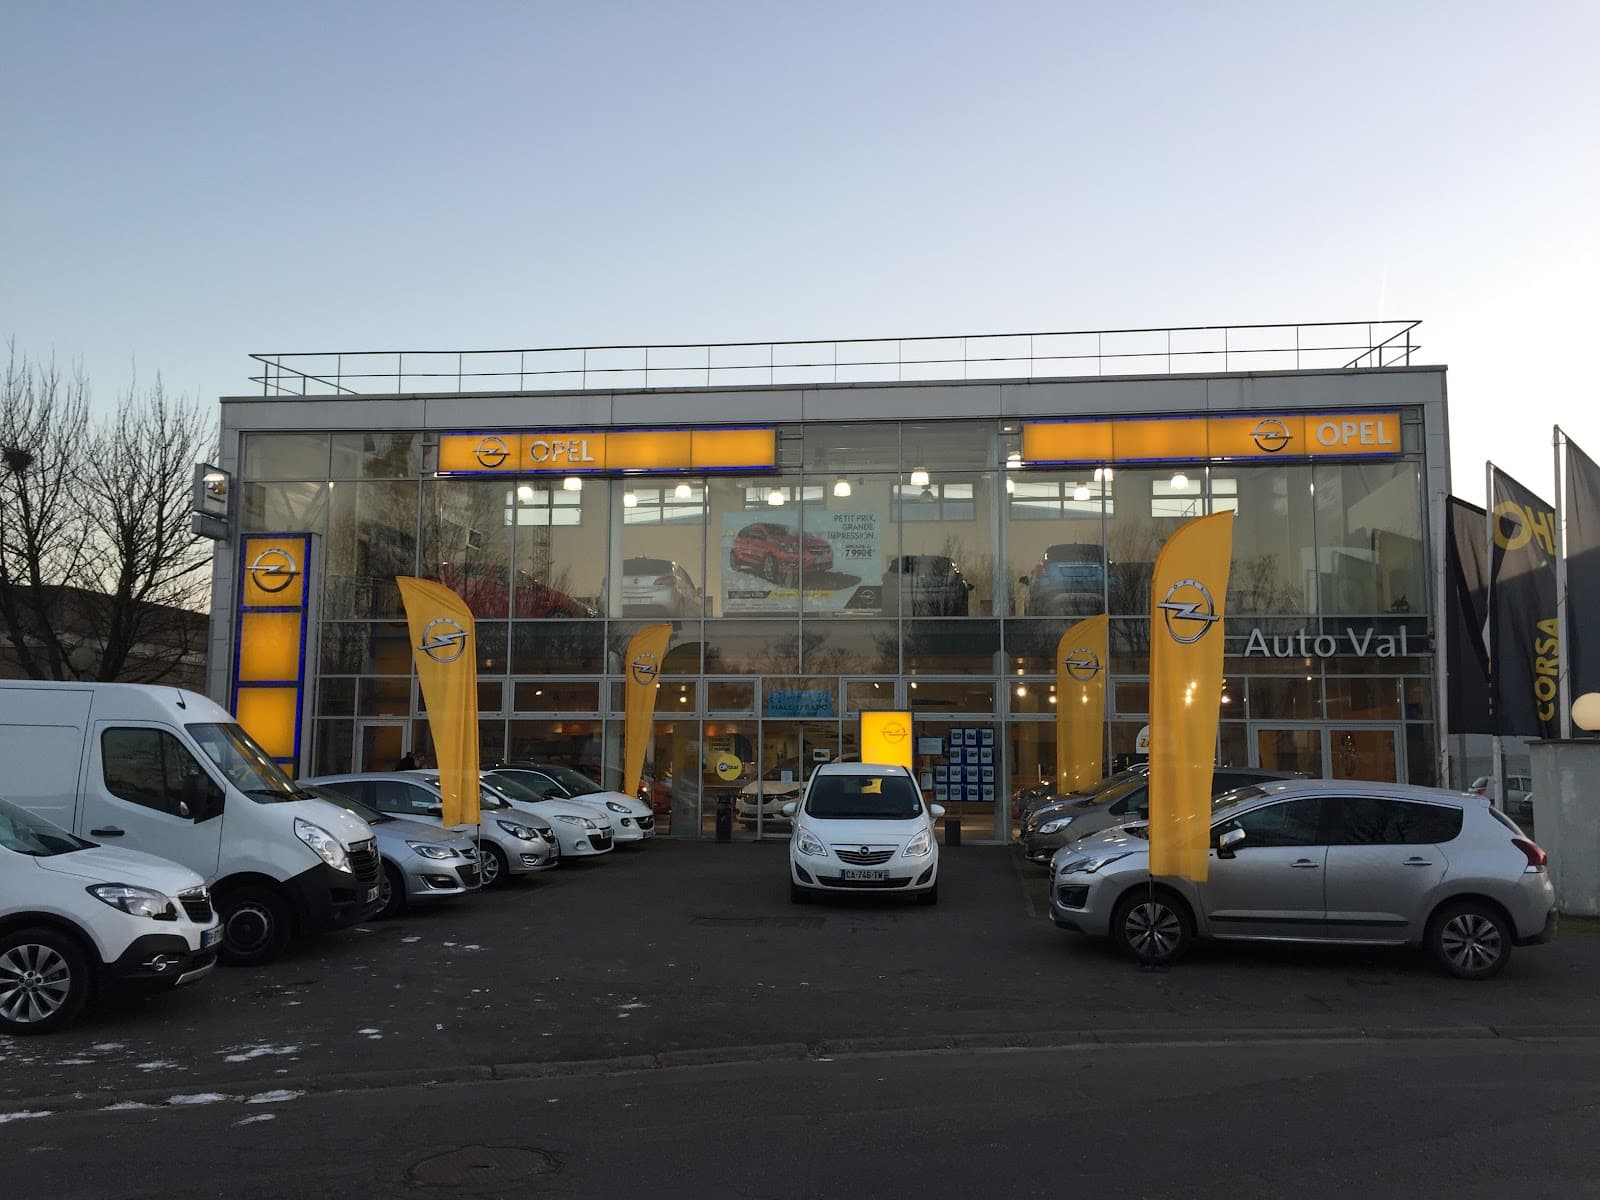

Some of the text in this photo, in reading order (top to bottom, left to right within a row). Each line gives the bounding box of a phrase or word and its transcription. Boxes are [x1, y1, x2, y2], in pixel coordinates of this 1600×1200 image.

[1316, 421, 1392, 446] OPEL
[530, 440, 594, 462] OPEL
[833, 514, 854, 522] PETIT
[842, 523, 874, 531] GRANDE
[1244, 625, 1408, 657] Auto Val
[1534, 617, 1559, 721] CORSA
